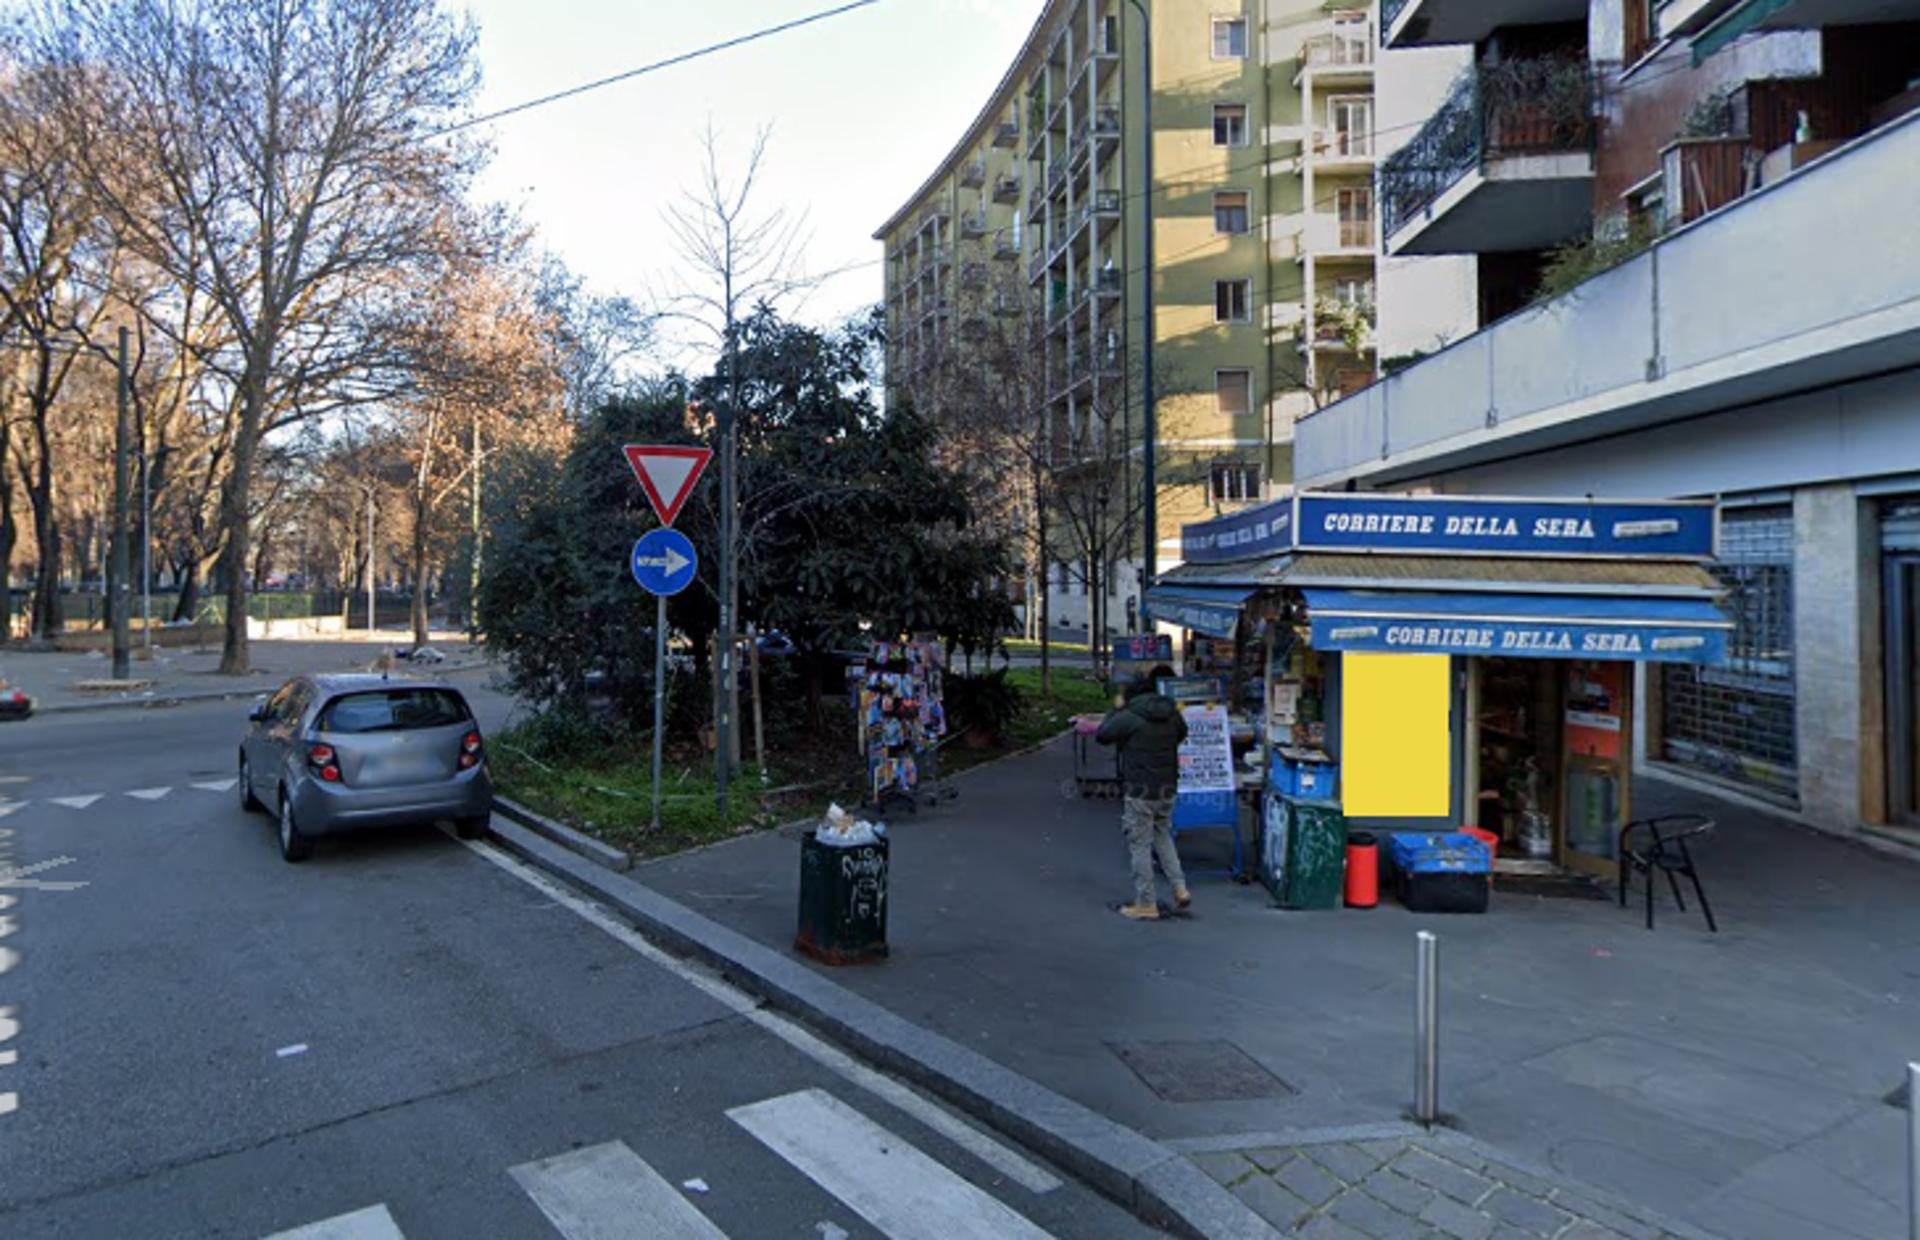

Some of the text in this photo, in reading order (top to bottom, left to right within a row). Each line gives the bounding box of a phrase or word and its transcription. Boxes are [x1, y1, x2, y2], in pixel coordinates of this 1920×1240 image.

[1323, 512, 1435, 534] CORRIERE
[1445, 515, 1519, 536] DELLA
[1532, 517, 1595, 538] SERA
[1384, 626, 1495, 648] CORRIERE
[1501, 630, 1573, 650] DELLA
[1582, 632, 1642, 652] SERA
